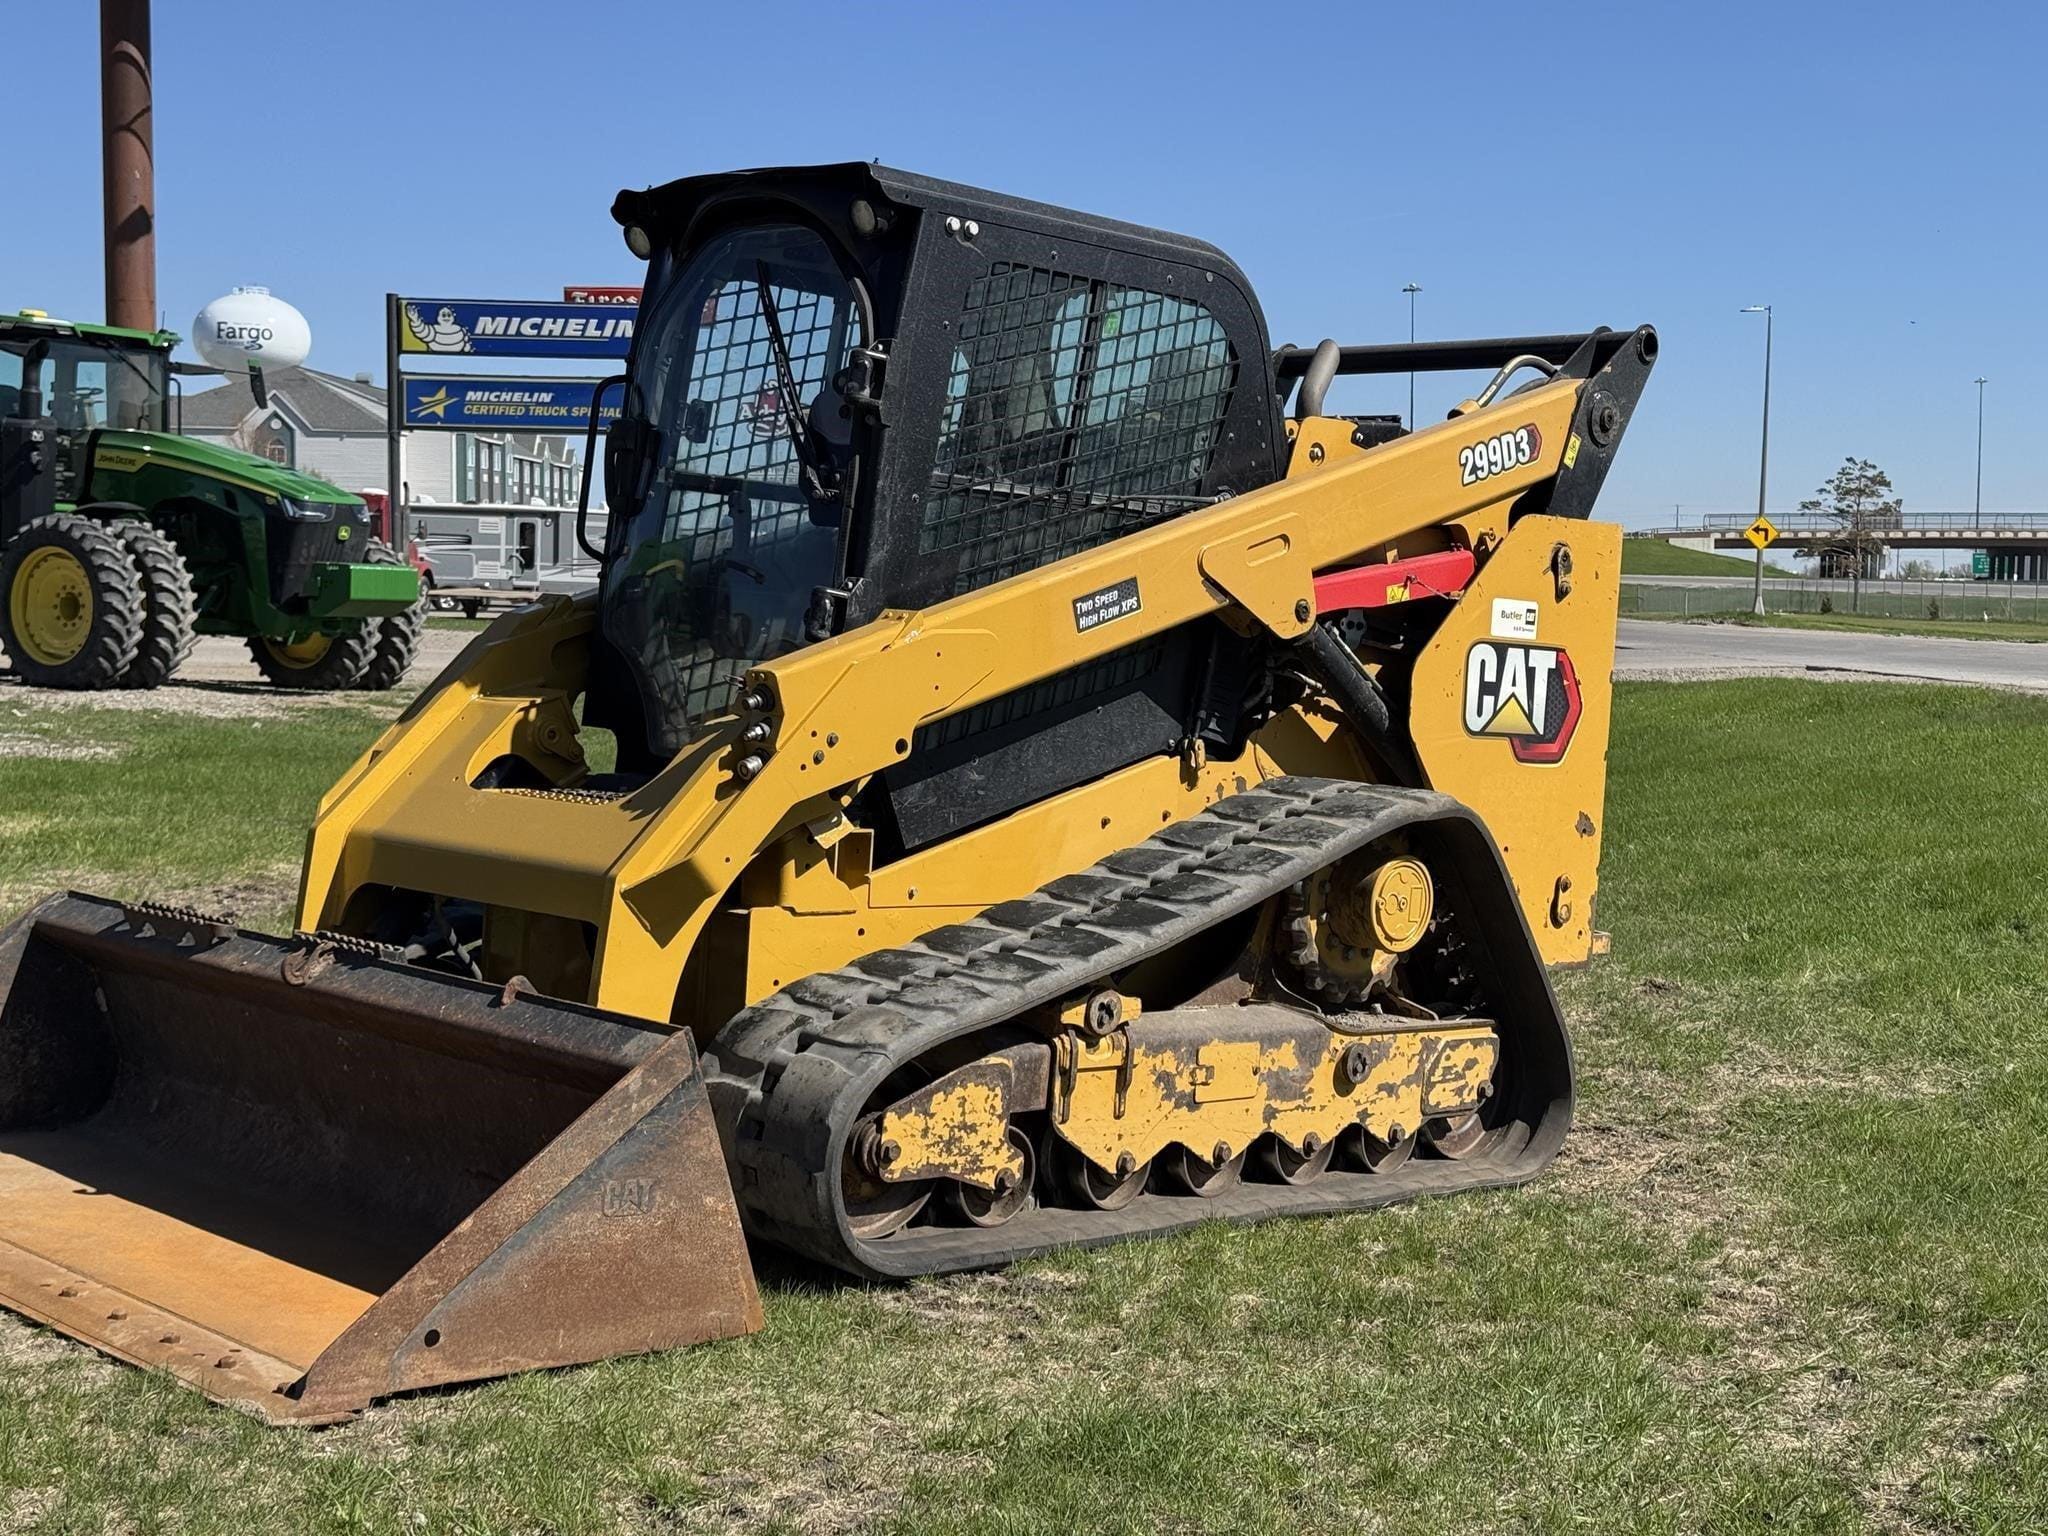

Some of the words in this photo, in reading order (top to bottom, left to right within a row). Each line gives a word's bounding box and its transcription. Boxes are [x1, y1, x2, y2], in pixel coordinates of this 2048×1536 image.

[216, 321, 273, 344] Fargo
[474, 316, 634, 338] MICHELIN
[465, 390, 554, 403] MICHELIN
[464, 404, 525, 416] CERTIFIED
[529, 406, 568, 417] TRUCK
[571, 406, 622, 418] SPCIAL
[1460, 428, 1530, 486] 299D3
[1121, 596, 1138, 613] XPS
[1501, 610, 1522, 620] Butler
[1465, 643, 1557, 735] CAT
[602, 1178, 656, 1217] CAT
